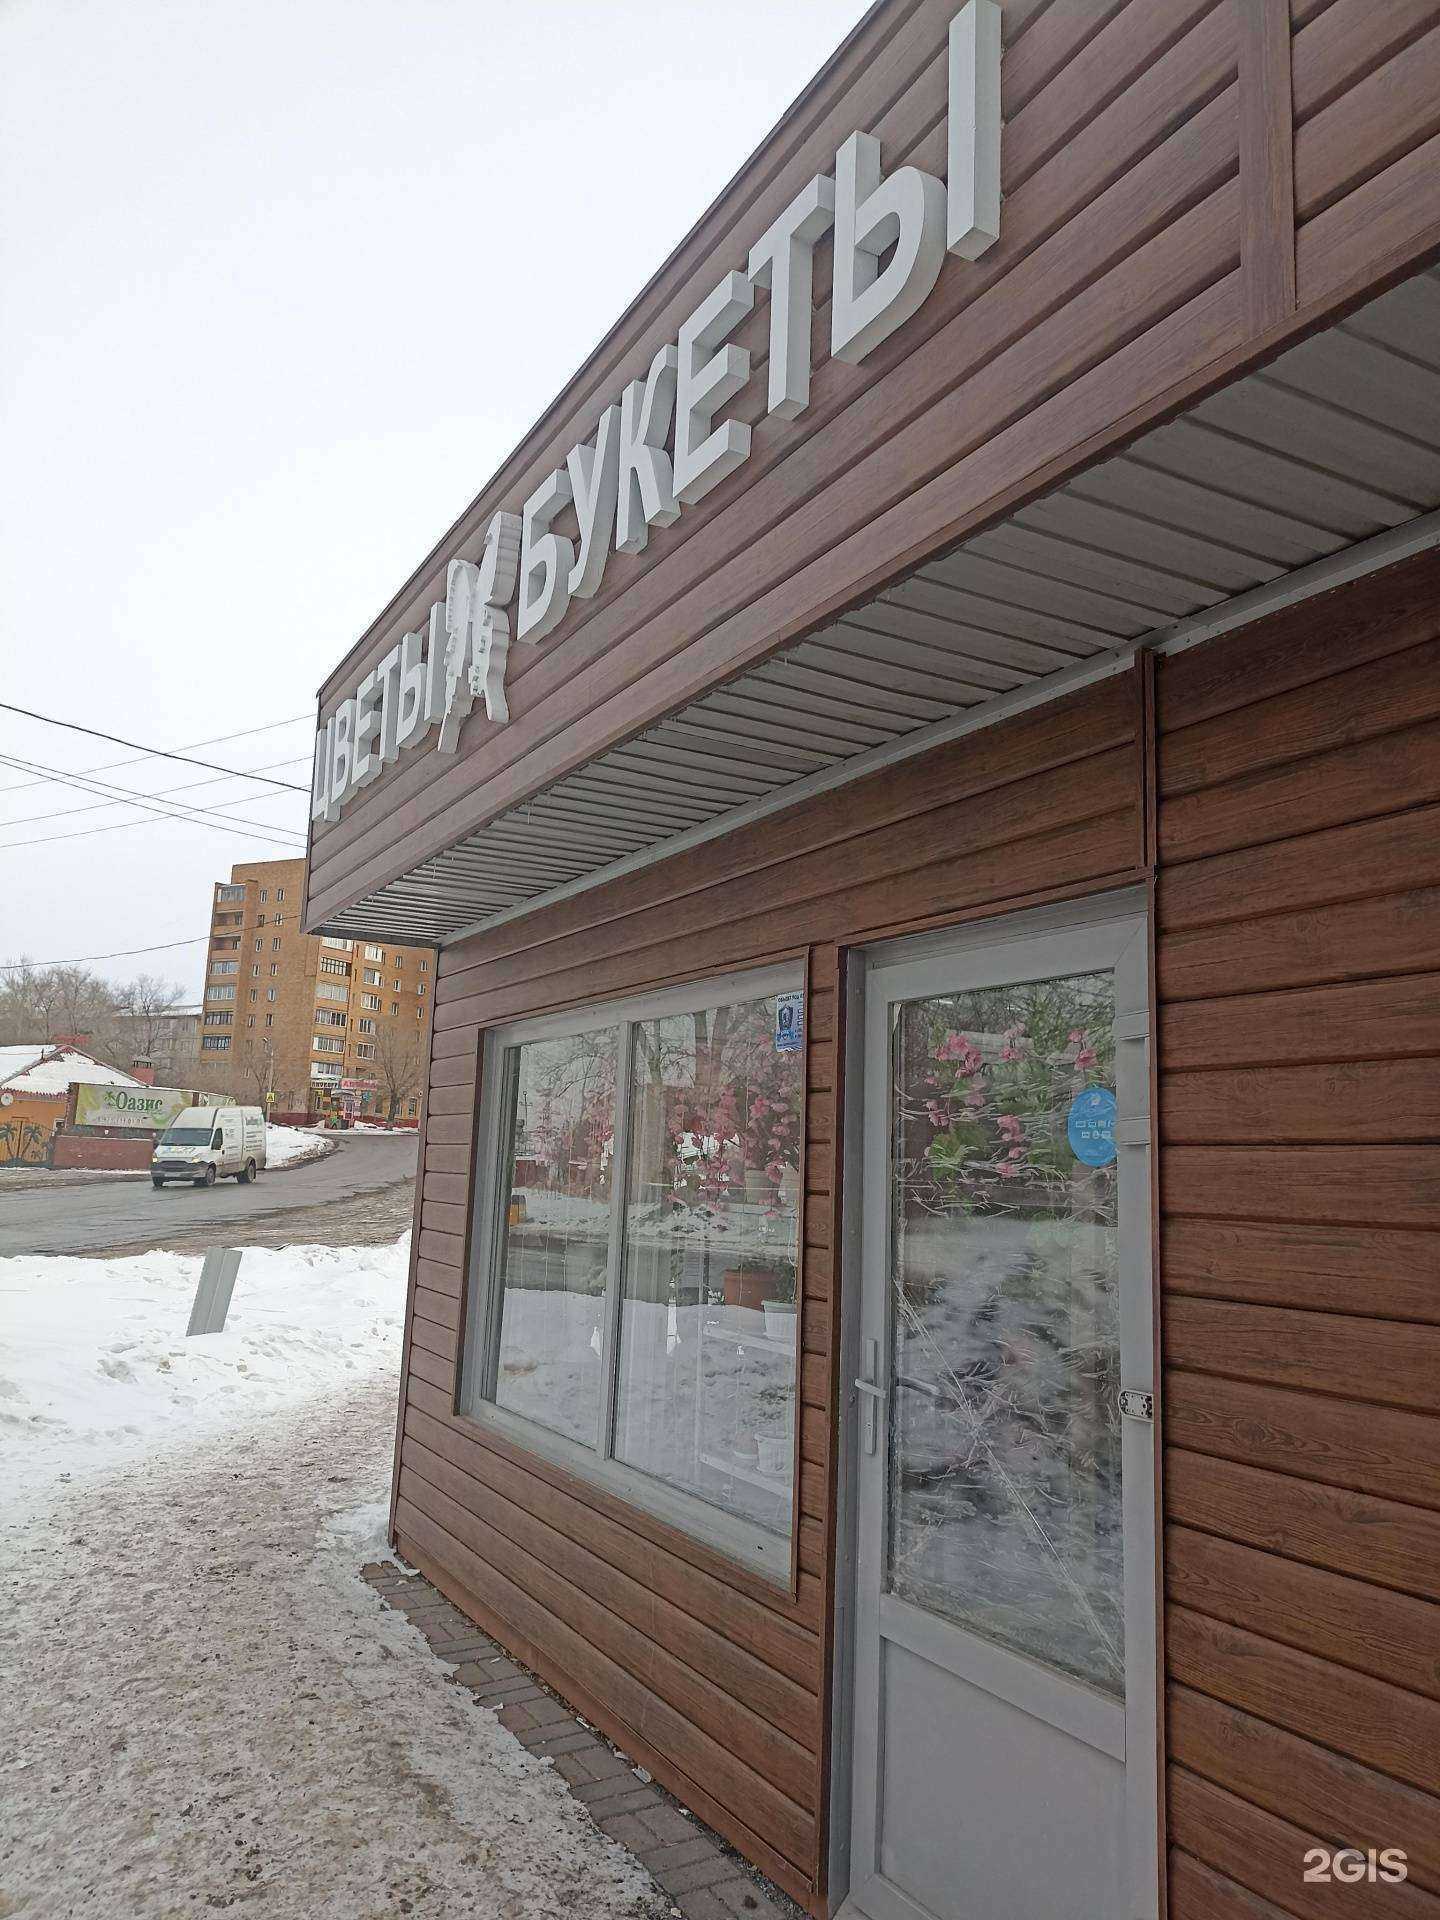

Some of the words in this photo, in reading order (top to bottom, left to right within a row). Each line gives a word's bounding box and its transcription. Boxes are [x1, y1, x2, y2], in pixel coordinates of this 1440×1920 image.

[311, 602, 447, 823] ЦВЕТЫ
[516, 0, 1001, 646] БУКЕТЫ
[116, 1091, 163, 1111] Оазис
